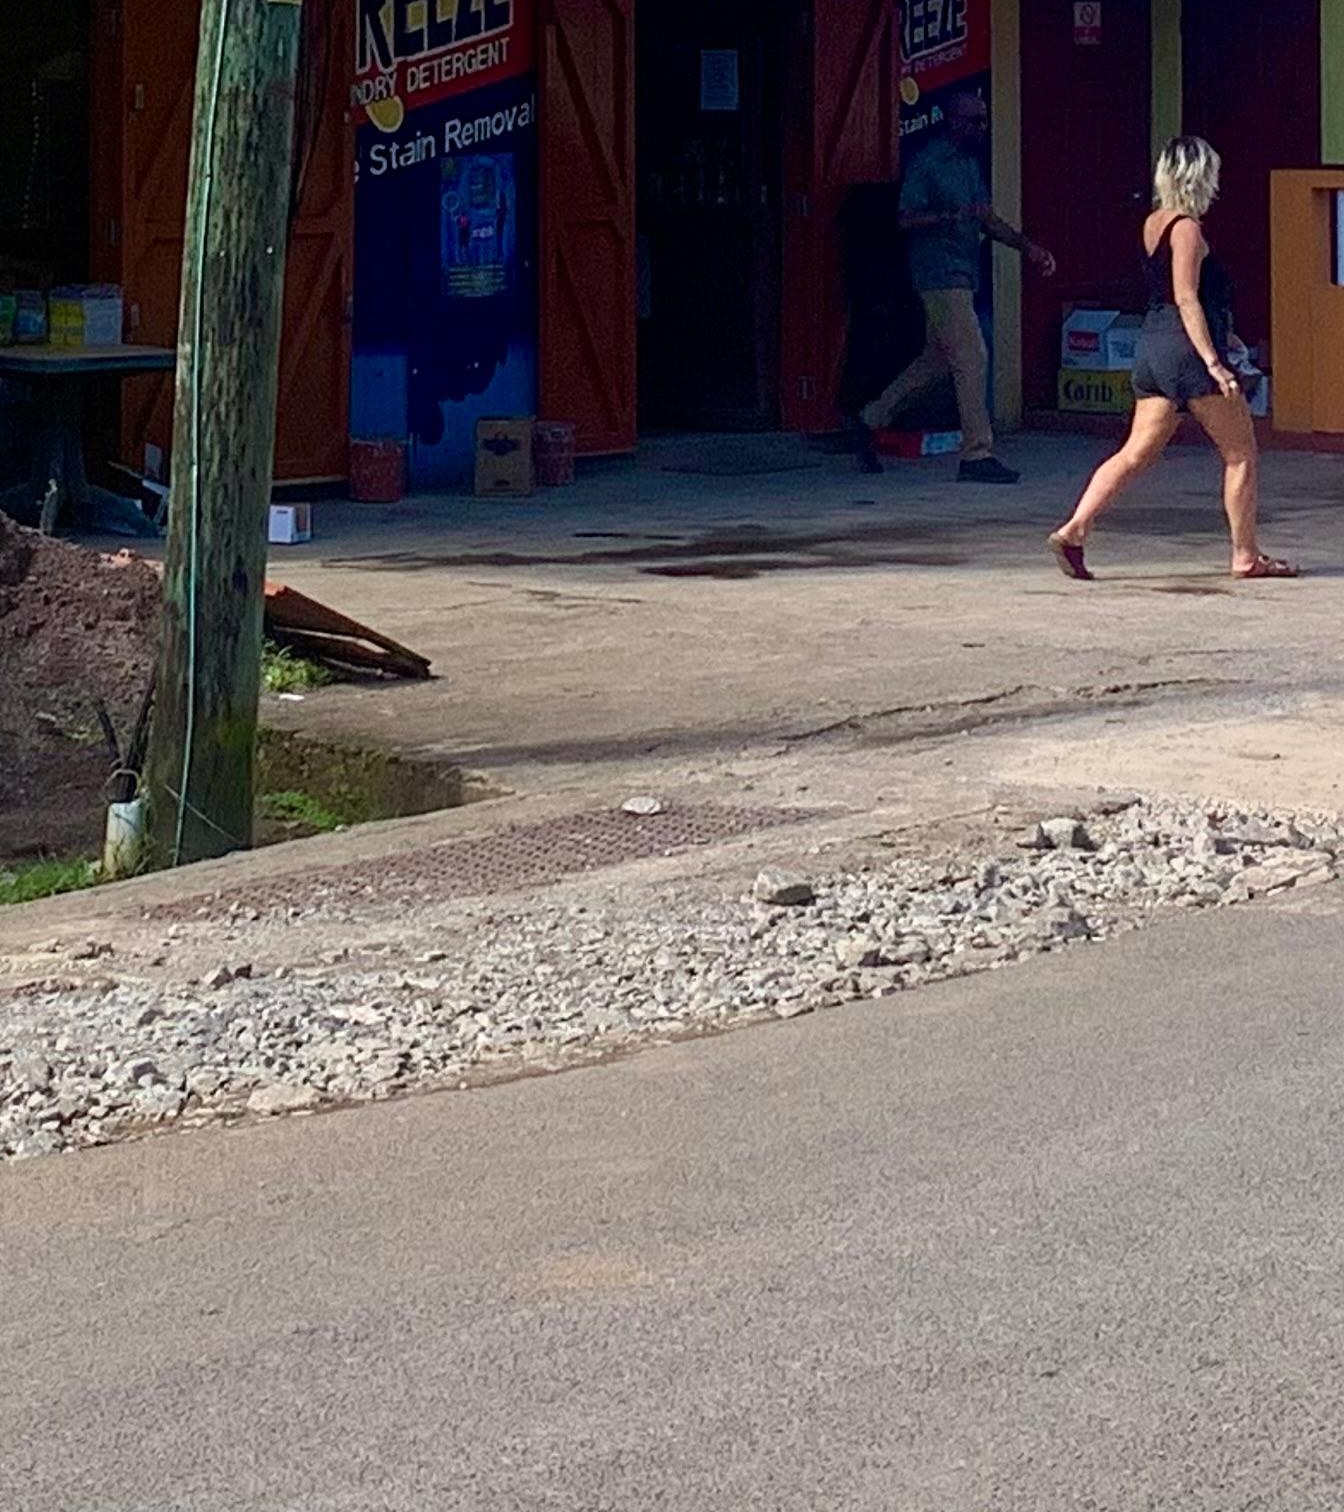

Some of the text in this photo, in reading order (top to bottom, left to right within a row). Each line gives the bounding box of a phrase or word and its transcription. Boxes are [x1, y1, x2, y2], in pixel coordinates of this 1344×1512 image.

[406, 36, 511, 93] DETERGENT
[368, 128, 437, 177] Stain
[444, 91, 536, 154] Removal
[1063, 378, 1113, 402] Carib
